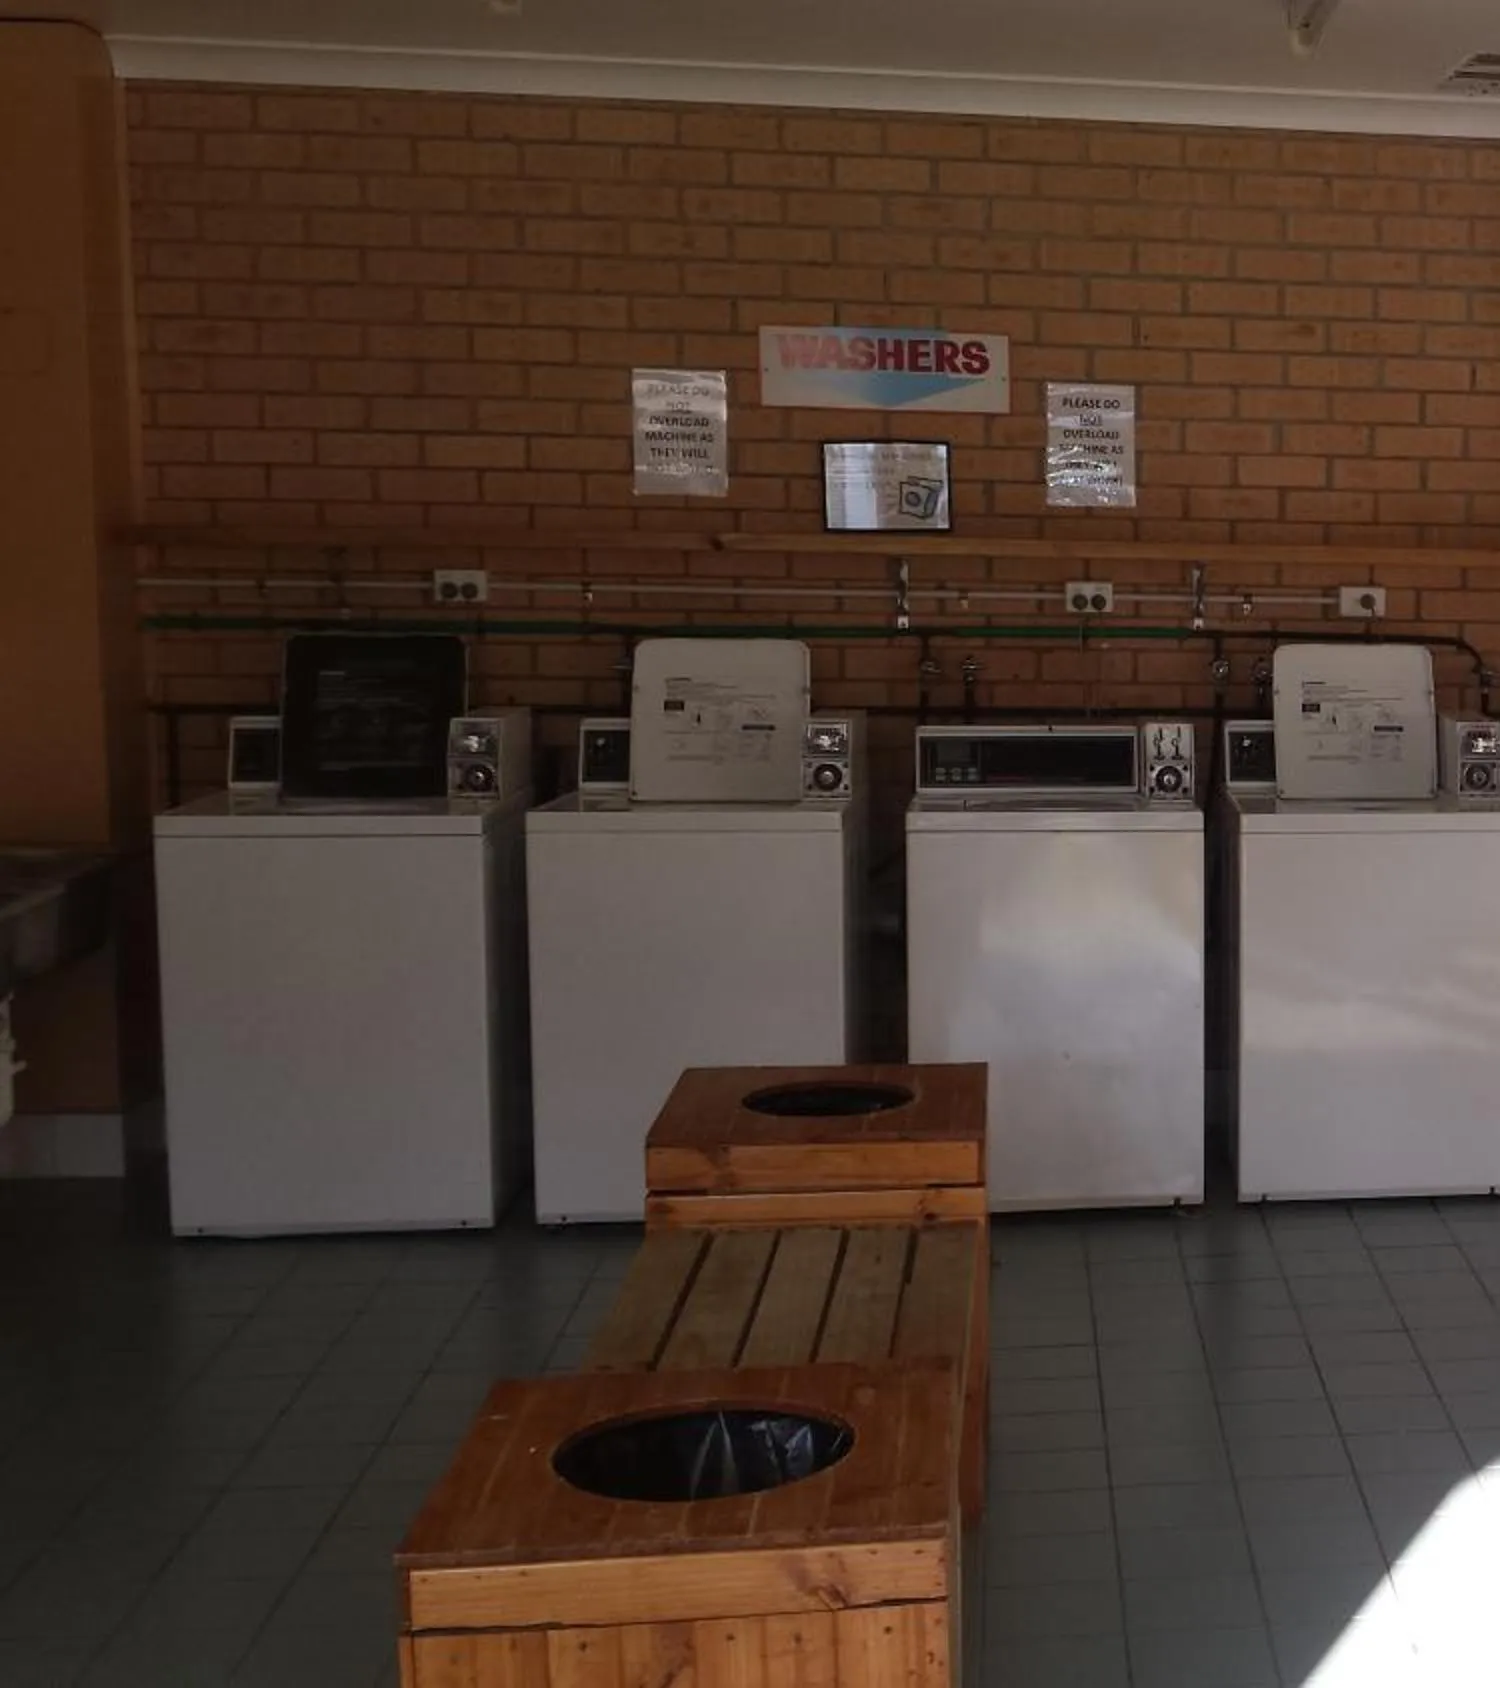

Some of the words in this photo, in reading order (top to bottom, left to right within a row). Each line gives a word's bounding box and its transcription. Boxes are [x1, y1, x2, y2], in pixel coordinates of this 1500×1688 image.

[776, 335, 990, 374] WASHERS
[1062, 397, 1101, 409] PLEASE
[1103, 399, 1121, 410] DO
[648, 415, 710, 428] OVERLOAD
[645, 431, 698, 443] MACHINE
[699, 432, 714, 443] AS
[1062, 428, 1120, 440] OVERLOAD
[650, 446, 678, 458] THEY
[681, 447, 710, 460] WILL
[1111, 445, 1124, 455] AS
